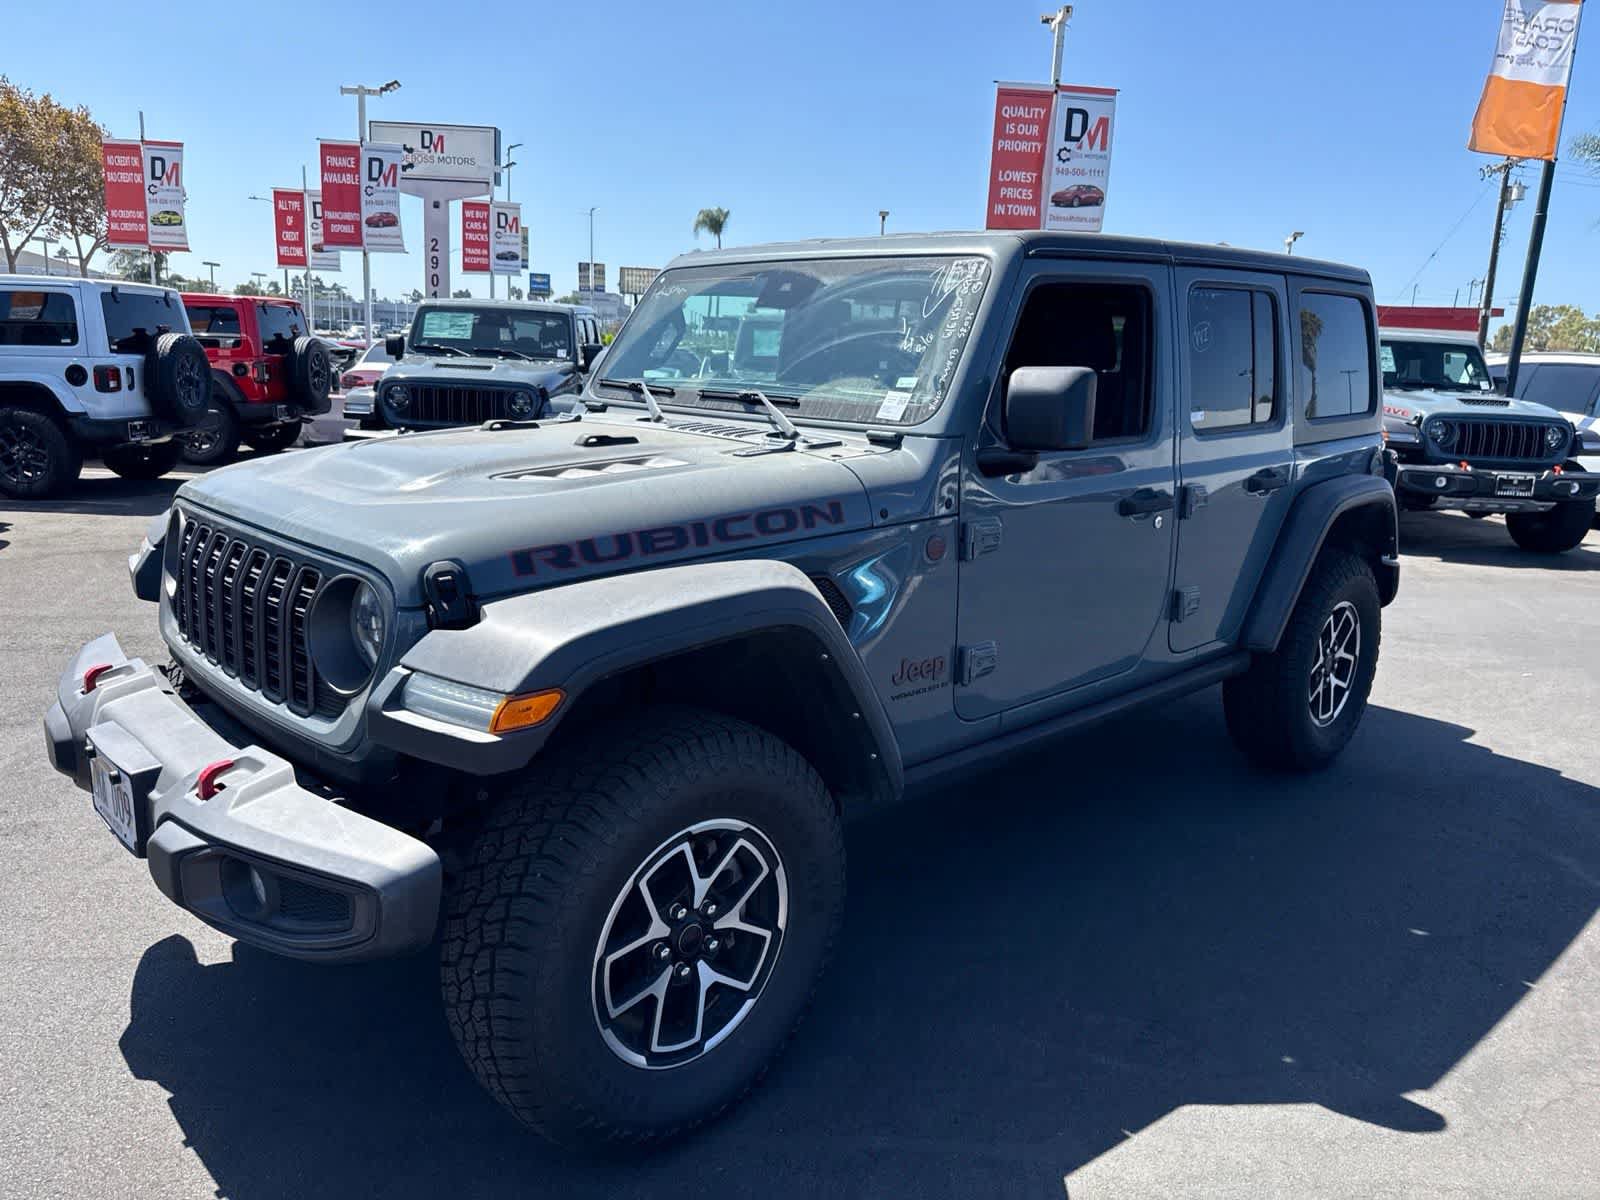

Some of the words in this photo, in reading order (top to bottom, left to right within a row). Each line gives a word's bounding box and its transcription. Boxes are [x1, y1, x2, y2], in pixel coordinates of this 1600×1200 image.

[1002, 105, 1047, 119] QUALITY
[1006, 122, 1016, 134] IS
[1016, 124, 1039, 137] OUR
[997, 140, 1042, 153] PRIORITY
[326, 155, 356, 168] FINANCE
[437, 156, 476, 166] MOTORS
[998, 170, 1037, 184] LOWEST
[1000, 188, 1033, 200] PRICES
[278, 199, 288, 211] ALL
[288, 200, 302, 212] TYPE
[994, 204, 1005, 215] IN
[1007, 204, 1036, 217] TOWN
[286, 215, 294, 226] OF
[464, 209, 476, 219] WE
[475, 210, 488, 220] BUY
[465, 221, 481, 230] CARS
[281, 231, 299, 241] CREDIT
[464, 232, 488, 242] TRUCKS
[279, 246, 304, 257] WELCOME
[508, 501, 845, 577] RUBICON
[891, 656, 945, 687] Jeep
